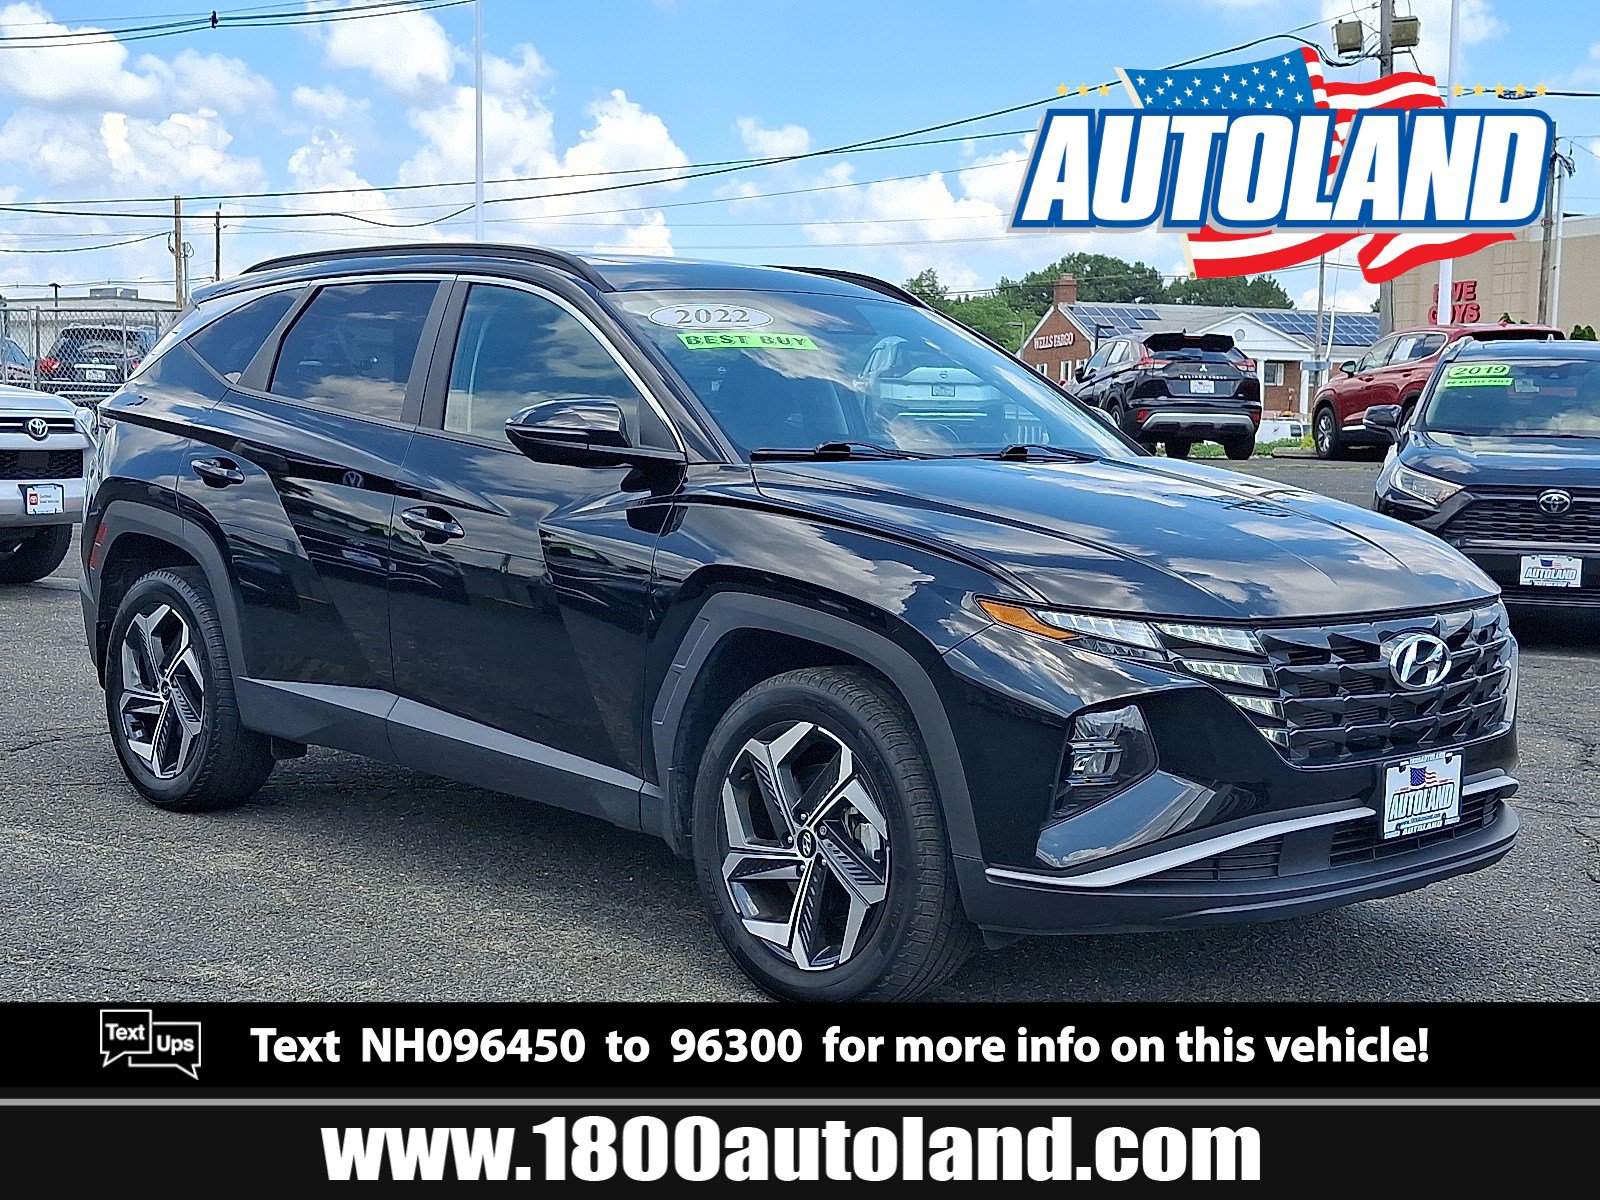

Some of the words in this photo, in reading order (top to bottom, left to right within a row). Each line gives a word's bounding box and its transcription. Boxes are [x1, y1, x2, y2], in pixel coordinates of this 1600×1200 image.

[674, 308, 750, 324] 2022
[686, 334, 747, 345] BEST
[760, 335, 807, 346] BUY
[1034, 334, 1053, 349] WELLS
[1053, 332, 1074, 347] FARGO
[1454, 365, 1507, 376] 2019
[1525, 567, 1577, 580] AUTOLAND
[1388, 782, 1455, 821] AUTOLAND
[1402, 821, 1442, 836] AUTOLAND
